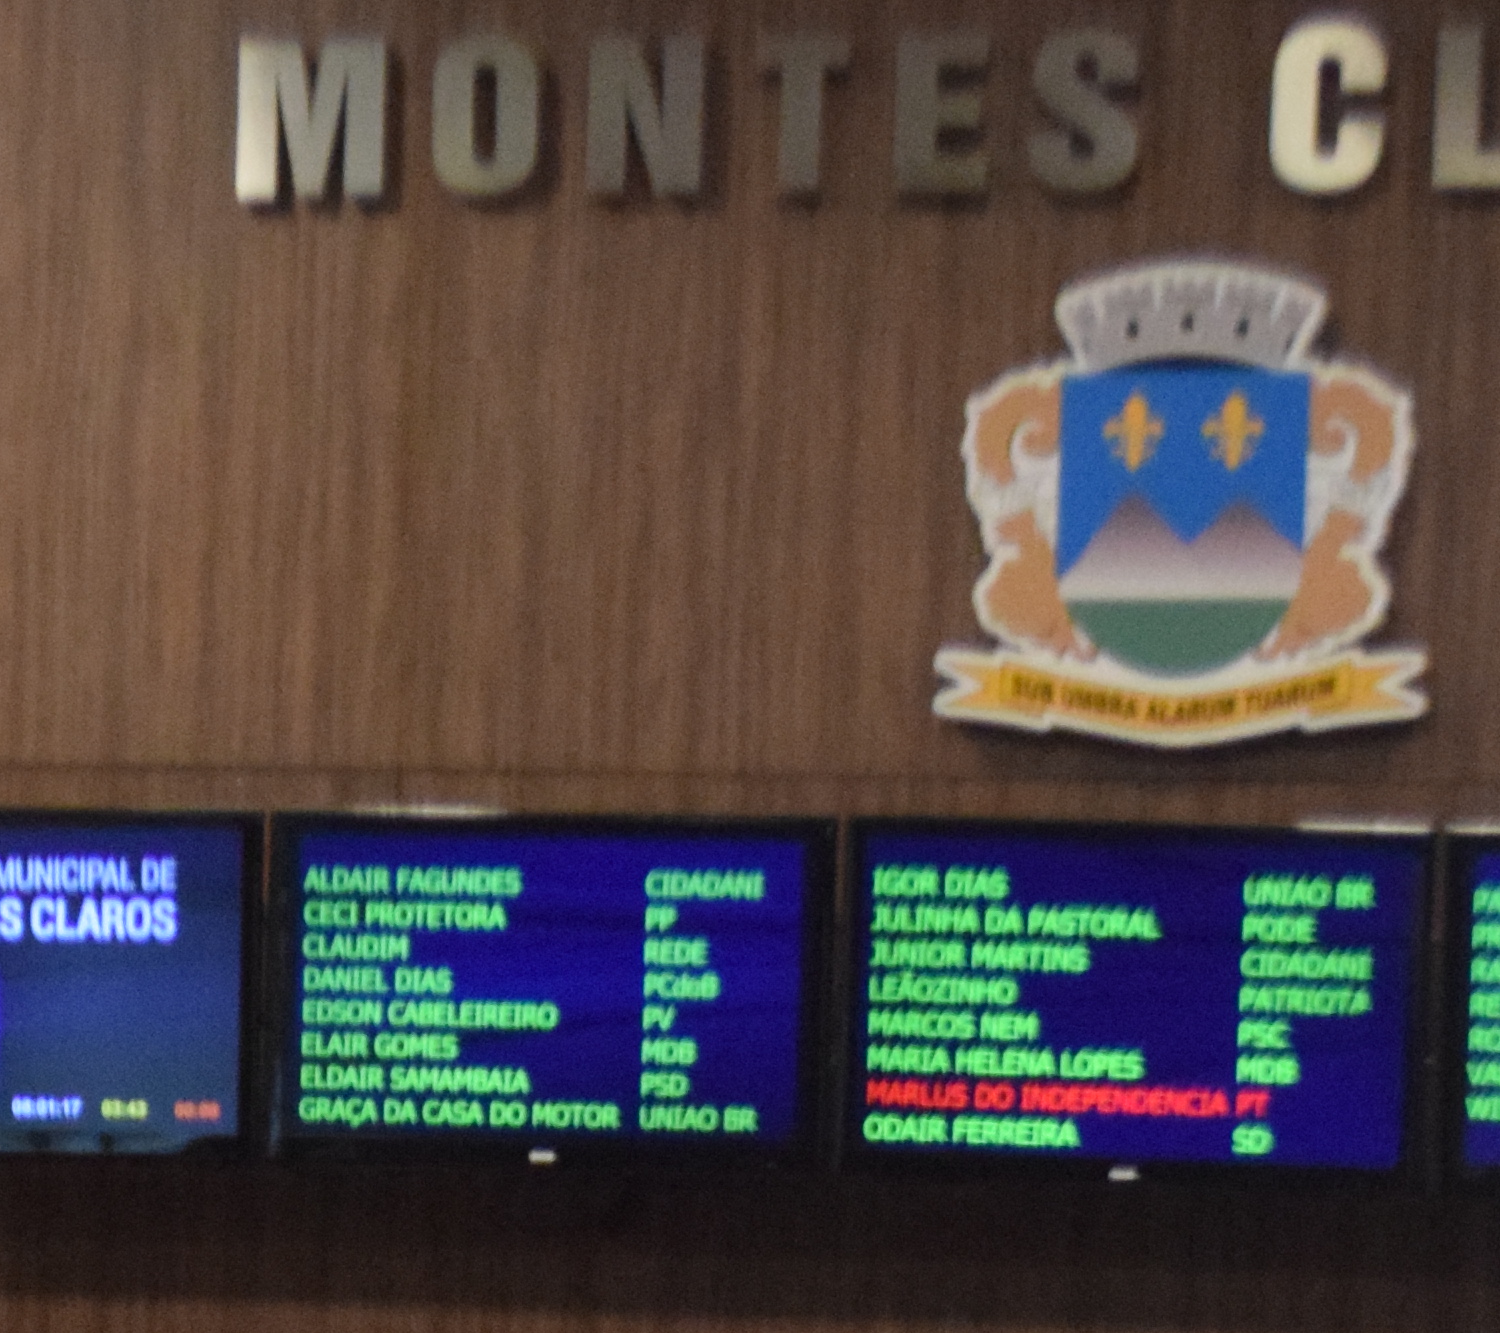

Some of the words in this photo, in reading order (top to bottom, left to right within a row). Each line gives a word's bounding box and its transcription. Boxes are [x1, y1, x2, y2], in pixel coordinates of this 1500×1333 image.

[233, 25, 1141, 203] MONTES
[141, 856, 177, 893] DE
[303, 864, 390, 894] ALDAIR
[396, 865, 523, 897] FAGUNDES
[873, 865, 938, 898] IGOR
[944, 866, 1010, 900] DIAS
[30, 896, 177, 943] CLAROS
[303, 901, 359, 928] CECI
[364, 902, 507, 932] PROTETORA
[870, 902, 981, 934] JULINHA
[984, 904, 1023, 936] DA
[1027, 905, 1162, 940] PASTORAL
[1242, 912, 1318, 943] PODE
[302, 932, 410, 961] CLAUDIM
[644, 938, 708, 966] REDE
[971, 940, 1091, 973] MARTINS
[303, 966, 390, 993] DANIEL
[394, 967, 454, 995] DIAS
[868, 970, 1020, 1005] LEÃOZINHO
[302, 1000, 383, 1026] EDSON
[387, 1000, 561, 1031] CABELEIREIRO
[1238, 984, 1373, 1016] PATRIOTA
[867, 1009, 977, 1041] MARCOS
[980, 1011, 1041, 1042] NEM
[301, 1032, 370, 1059] ELAIR
[374, 1033, 460, 1061] GOMES
[641, 1038, 698, 1066] MDB
[866, 1045, 950, 1074] MARIA
[955, 1047, 1056, 1077] HELENA
[1060, 1048, 1146, 1081] LOPES
[300, 1065, 385, 1092] ELDAIR
[390, 1066, 531, 1096] SAMAMBAIA
[640, 1072, 691, 1099] PSD
[1236, 1053, 1301, 1086] MDB
[866, 1079, 970, 1110] MARLUS
[974, 1081, 1016, 1111] DO
[1235, 1088, 1271, 1117] PT
[298, 1097, 378, 1128] GRAÇA
[383, 1098, 418, 1126] DA
[422, 1100, 484, 1127] CASA
[489, 1101, 527, 1128] DO
[532, 1101, 621, 1130] MOTOR
[863, 1113, 948, 1142] ODAIR
[952, 1115, 1081, 1148] FERREIRA
[1232, 1122, 1273, 1155] SD
